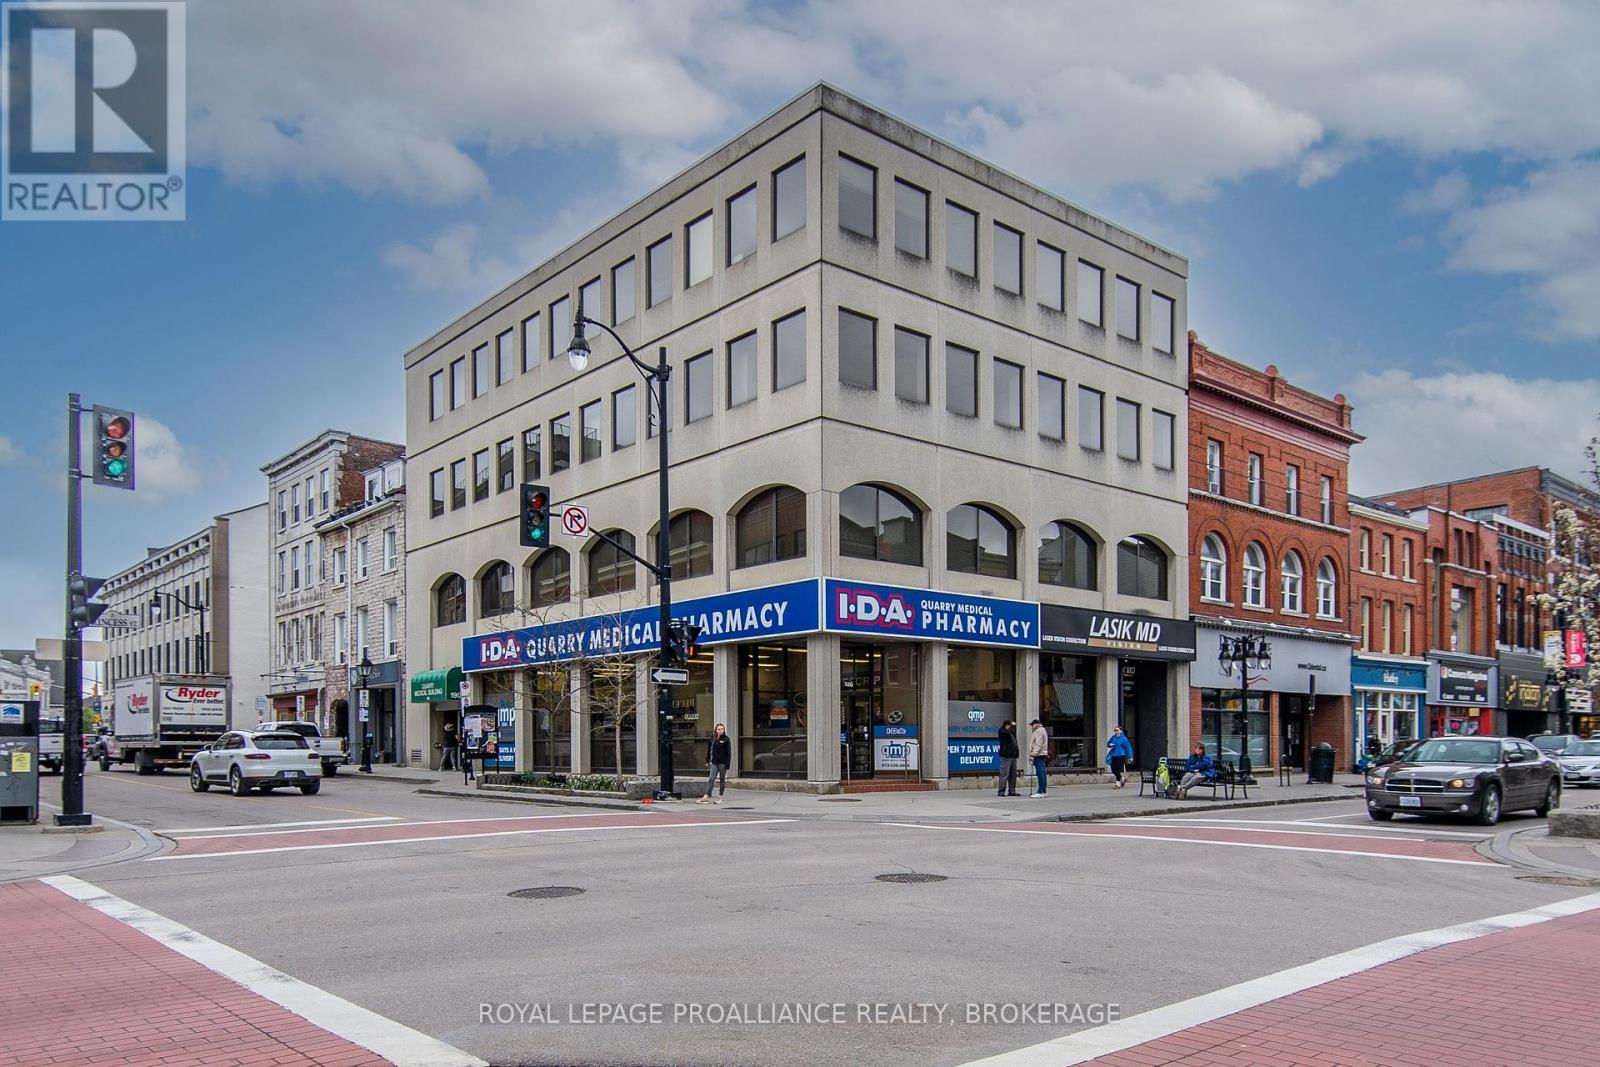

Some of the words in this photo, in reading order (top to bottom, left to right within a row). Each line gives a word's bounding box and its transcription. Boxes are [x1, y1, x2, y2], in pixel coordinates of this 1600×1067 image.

[920, 599, 956, 612] QUARRY
[957, 604, 993, 616] MEDICAL
[922, 611, 1031, 639] PHARMACY
[1089, 616, 1135, 640] LASIK
[1135, 621, 1161, 642] MD
[526, 631, 586, 660] QUARRY
[589, 621, 661, 650] MEDICAL
[1065, 637, 1087, 645] CORRECTION
[1106, 640, 1141, 649] VISION
[177, 687, 220, 700] Ryder
[961, 745, 966, 754] 7
[966, 745, 985, 754] DAYS
[985, 745, 992, 753] A
[959, 756, 994, 765] DELIVERY
